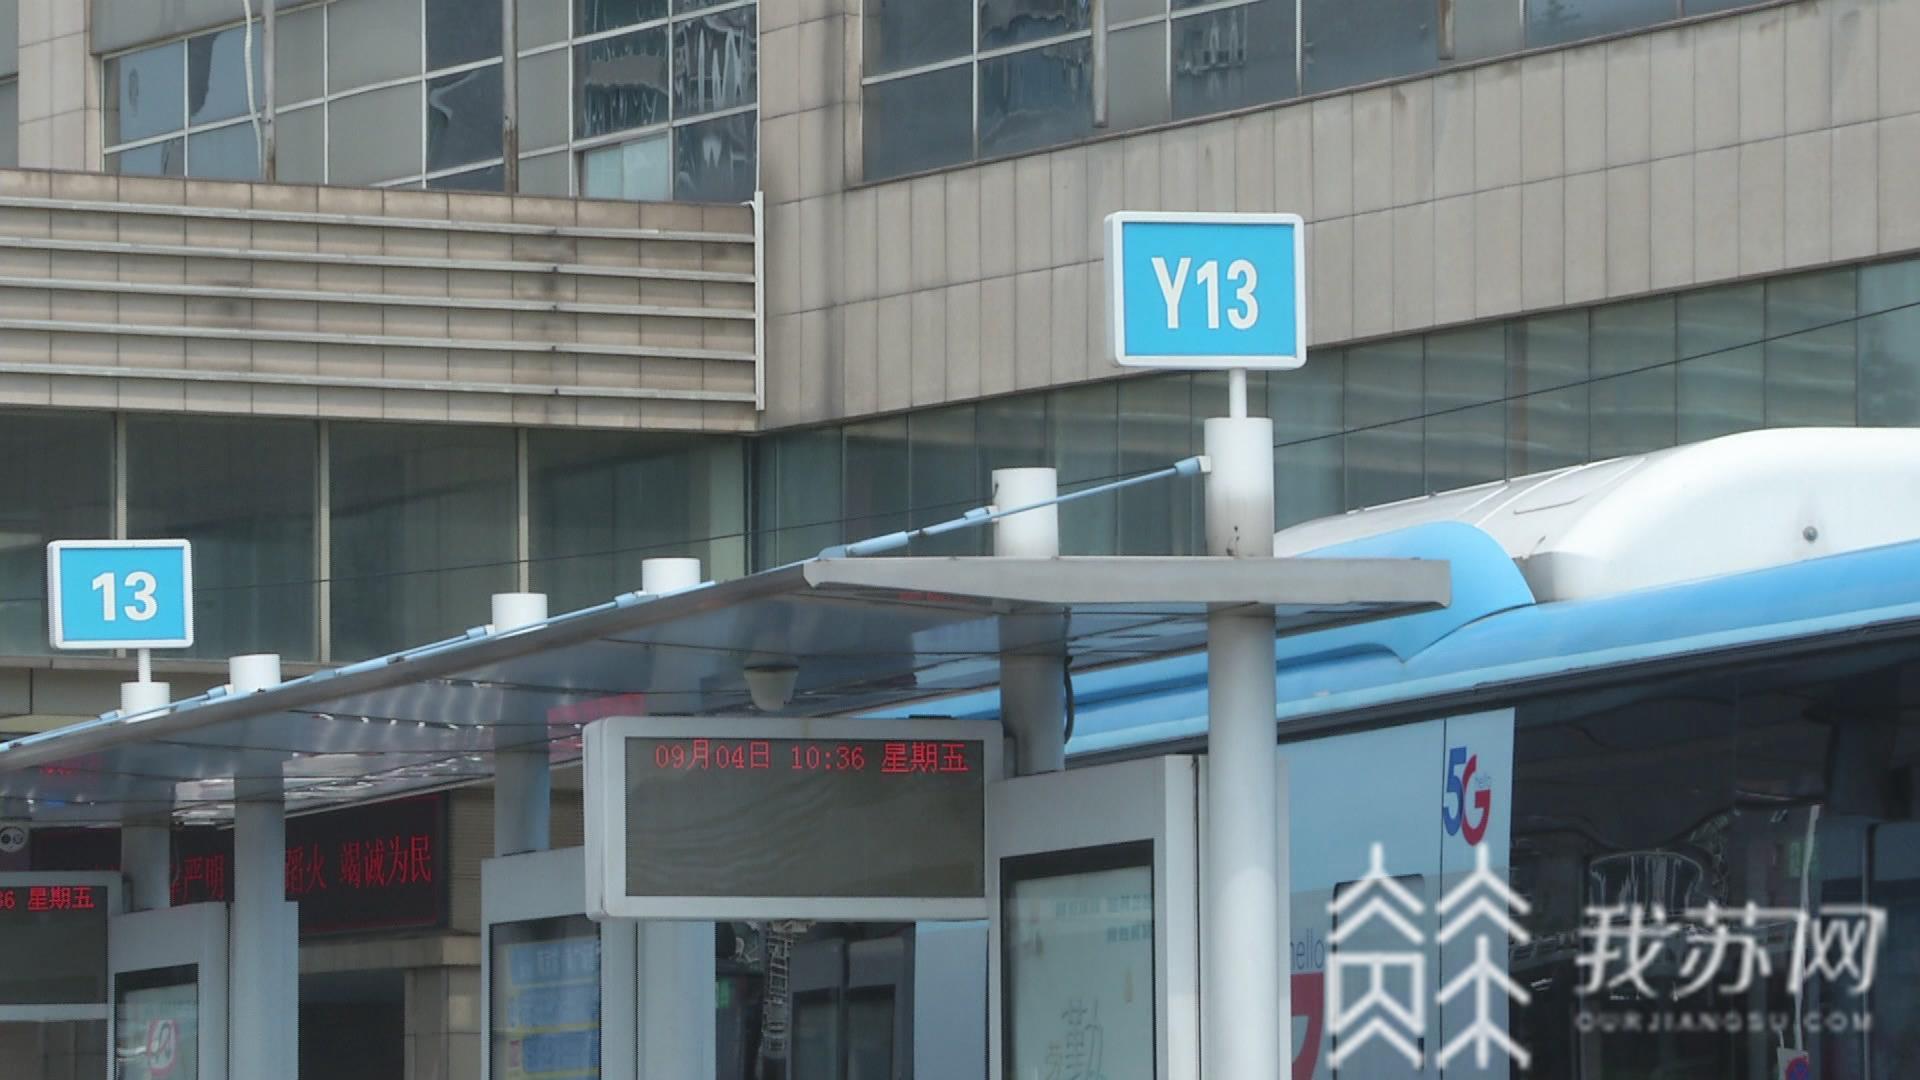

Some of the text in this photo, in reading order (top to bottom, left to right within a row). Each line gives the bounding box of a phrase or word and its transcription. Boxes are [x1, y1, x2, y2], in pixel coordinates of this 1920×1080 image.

[1151, 256, 1259, 330] Y13
[91, 571, 158, 622] 13
[655, 738, 969, 773] 09月04日 10:36 星期五
[1443, 746, 1491, 847] 5G
[340, 834, 432, 889] 竭诚为民
[28, 886, 96, 912] 星期五
